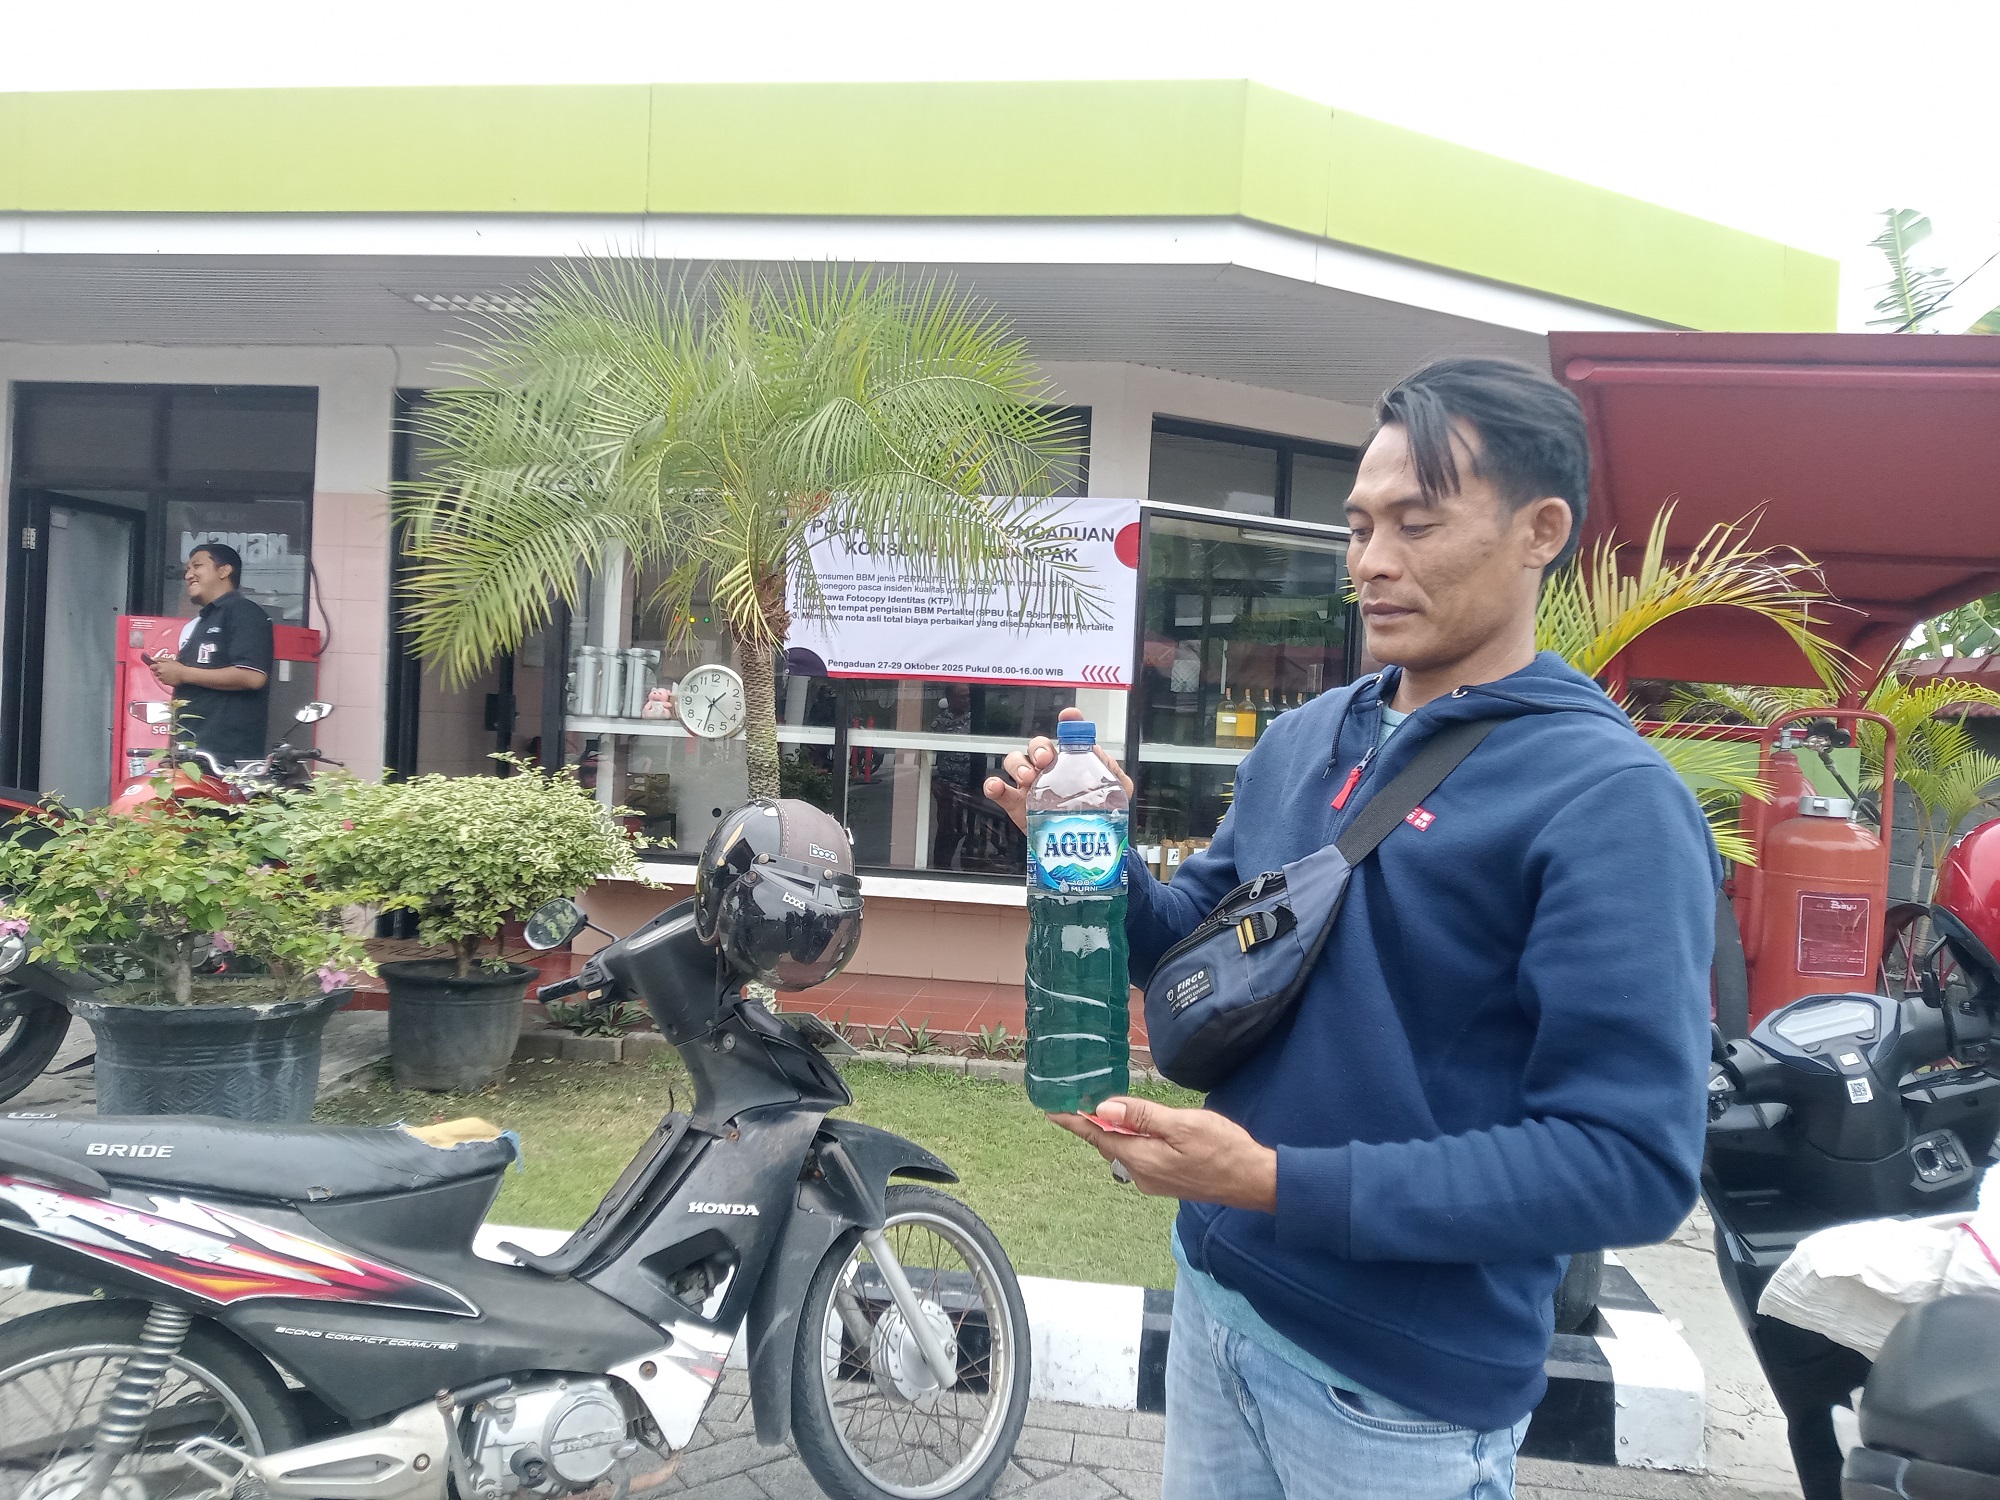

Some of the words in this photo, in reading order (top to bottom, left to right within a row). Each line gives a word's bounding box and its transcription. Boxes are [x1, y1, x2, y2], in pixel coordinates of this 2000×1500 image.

[845, 541, 954, 558] KONSU
[855, 573, 876, 581] BBM
[877, 574, 896, 584] jenis
[813, 582, 857, 592] ojonegoro
[857, 583, 882, 592] pasca
[884, 584, 913, 593] insiden
[914, 585, 945, 594] kualitas
[846, 593, 886, 604] Fotocopy
[887, 595, 926, 604] Identitas
[927, 596, 953, 606] (KTP)
[838, 604, 868, 613] tempat
[869, 605, 912, 614] pengisian
[914, 606, 935, 614] BBM
[936, 607, 974, 616] Pertalite
[975, 608, 1004, 618] (SPBU
[883, 615, 903, 623] total
[905, 616, 929, 625] biaya
[930, 617, 974, 626] perbaikan
[976, 620, 998, 628] yang
[1053, 622, 1074, 631] BBM
[828, 659, 876, 669] Pengaduan
[878, 661, 902, 670] 27-29
[904, 662, 940, 671] Oktober
[942, 663, 963, 672] 2025
[965, 665, 990, 673] Pukul
[992, 666, 1043, 675] 08.00-16.00
[1045, 668, 1064, 676] WIB
[700, 676, 708, 685] 11
[711, 673, 720, 683] 12
[690, 684, 699, 694] 10
[732, 688, 740, 698] 2
[684, 696, 692, 705] 9
[734, 701, 742, 711] 3
[687, 709, 695, 718] 8
[730, 713, 736, 723] 4
[696, 719, 702, 728] 7
[707, 723, 715, 733] 6
[719, 721, 728, 731] 5
[1044, 831, 1112, 862] AQUA
[1177, 970, 1205, 993] FIRGO
[86, 1142, 175, 1158] BRIDE
[687, 1201, 761, 1217] HONDA
[275, 1326, 322, 1338] ECONO
[324, 1332, 387, 1345] COMPACT
[388, 1338, 458, 1351] COMMUTER
